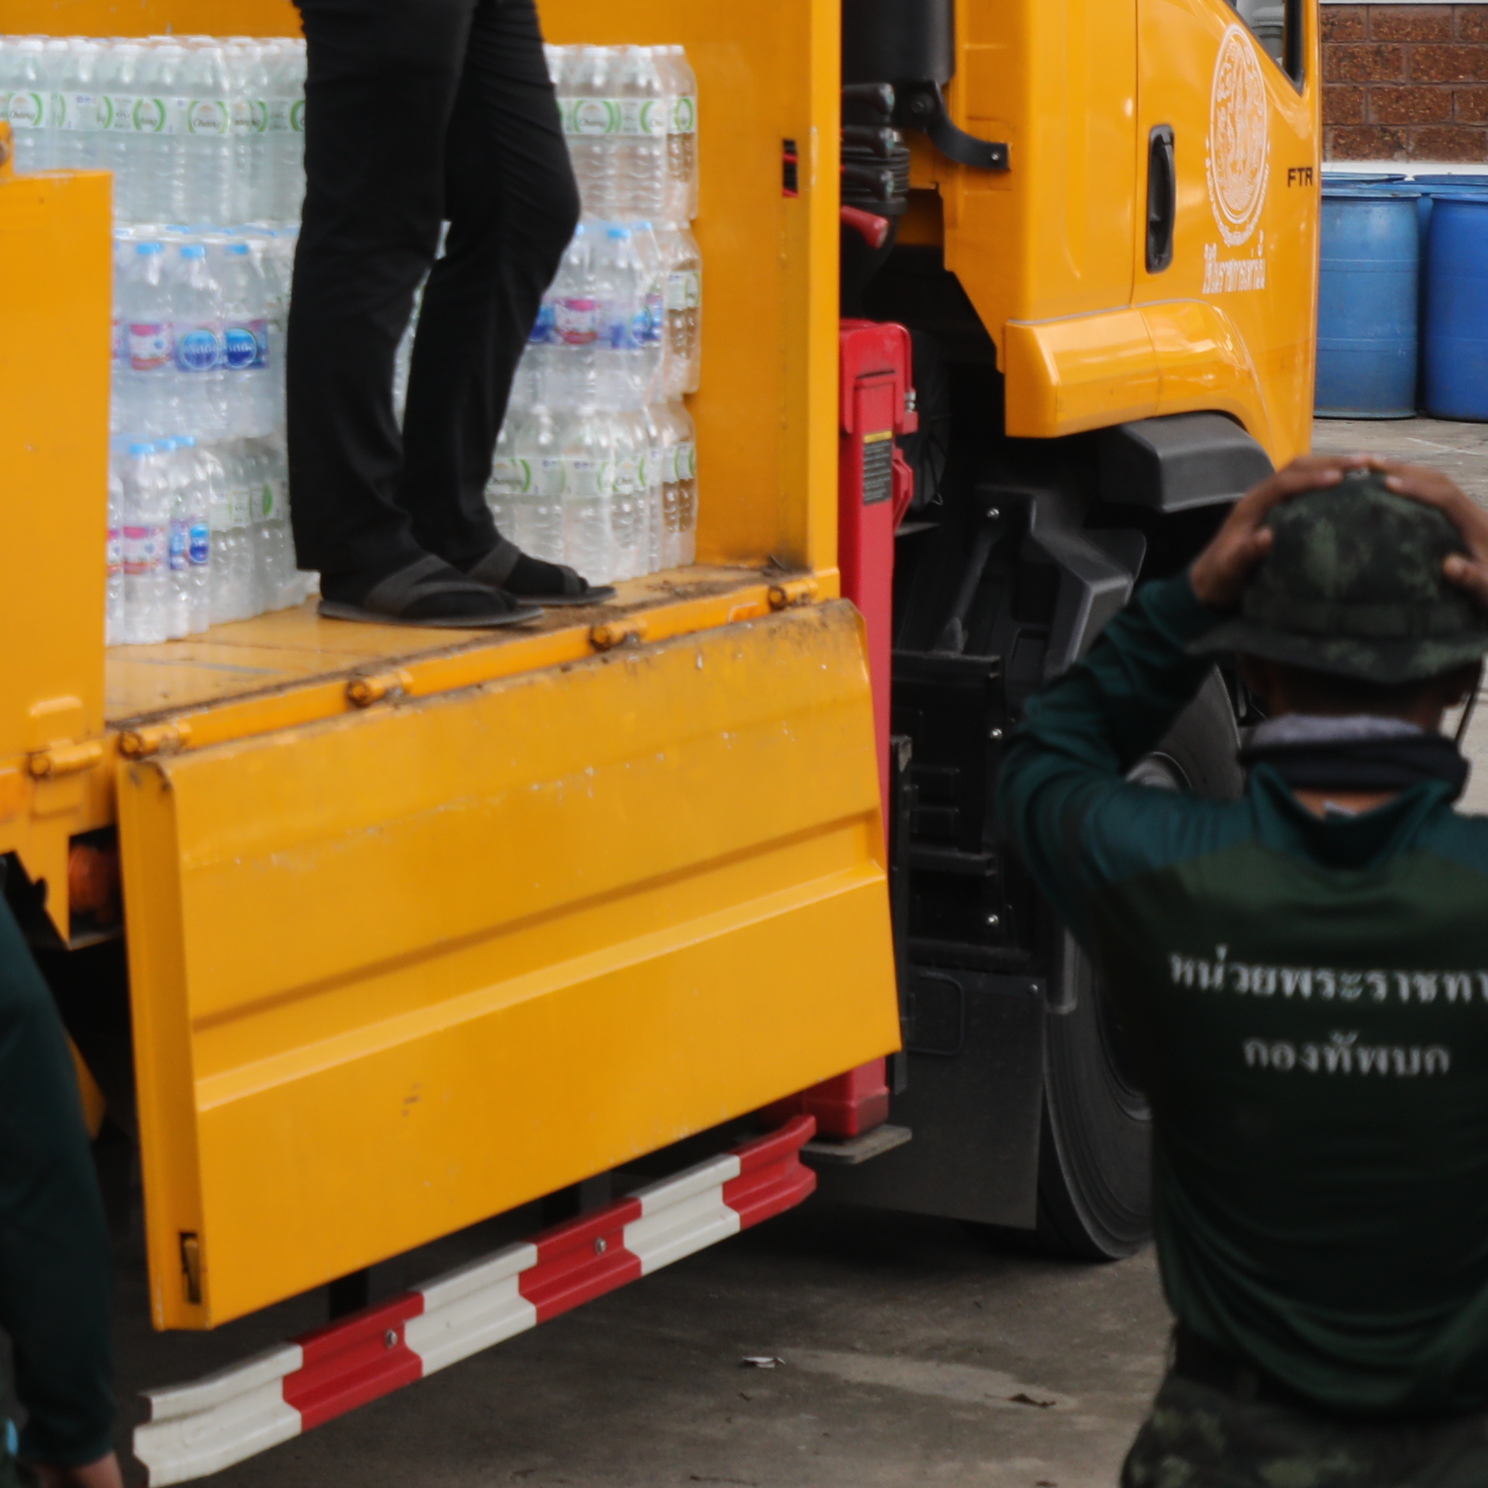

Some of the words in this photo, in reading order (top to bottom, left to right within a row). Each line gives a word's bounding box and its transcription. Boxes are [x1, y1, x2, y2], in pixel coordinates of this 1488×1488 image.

[1288, 167, 1313, 188] FTR
[1242, 1029, 1452, 1078] กองทัพบก
